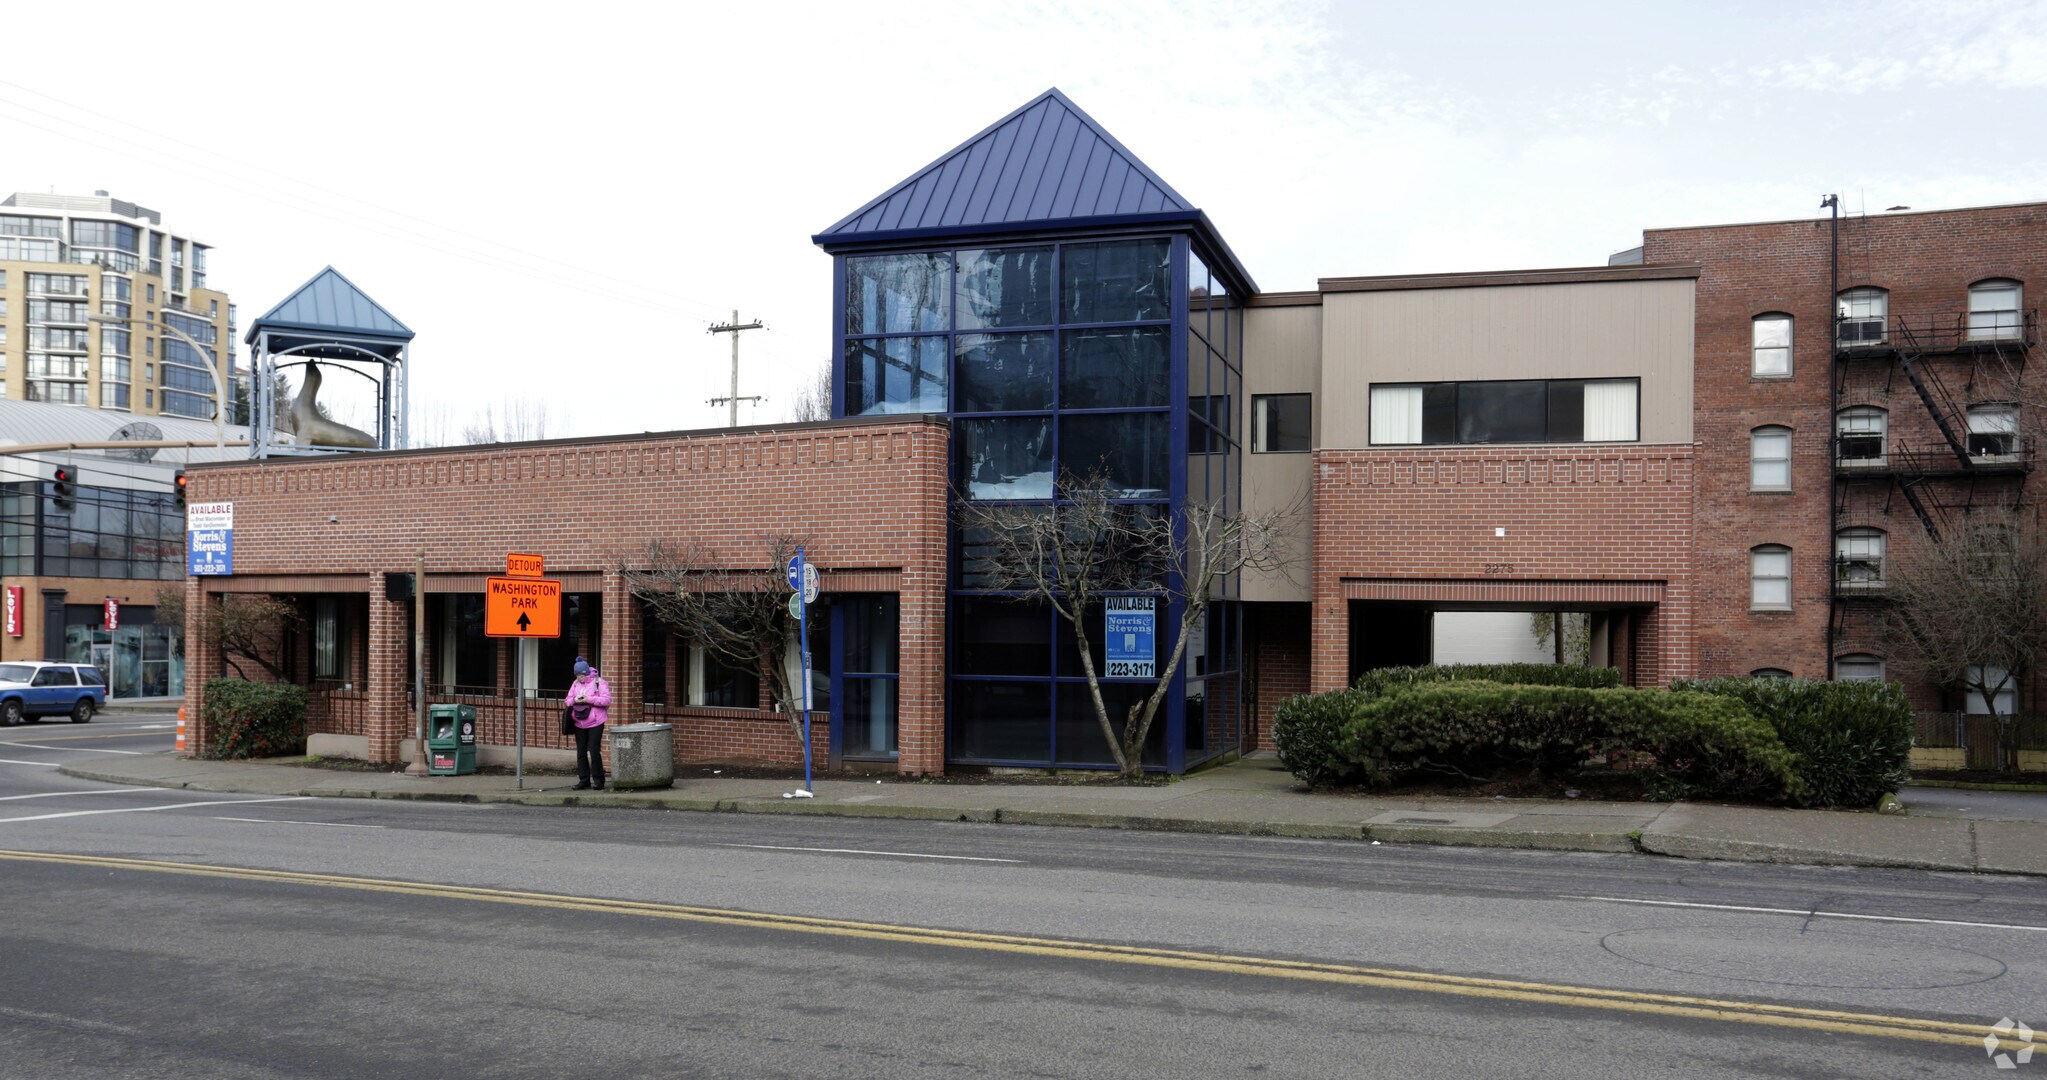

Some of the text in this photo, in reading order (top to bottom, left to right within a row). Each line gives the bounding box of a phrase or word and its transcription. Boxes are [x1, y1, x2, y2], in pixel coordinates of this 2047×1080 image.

[190, 505, 231, 514] AVAILABLE
[193, 531, 219, 541] Norris
[193, 542, 227, 552] Stevens
[509, 559, 541, 571] DETOUR
[1485, 563, 1514, 574] 2275
[493, 583, 556, 596] WASHINGTON
[511, 597, 538, 609] PARK
[1107, 597, 1153, 610] AVAILABLE
[1108, 616, 1142, 625] Norris
[1108, 625, 1152, 633] Stevens
[1111, 662, 1153, 676] 223-3171
